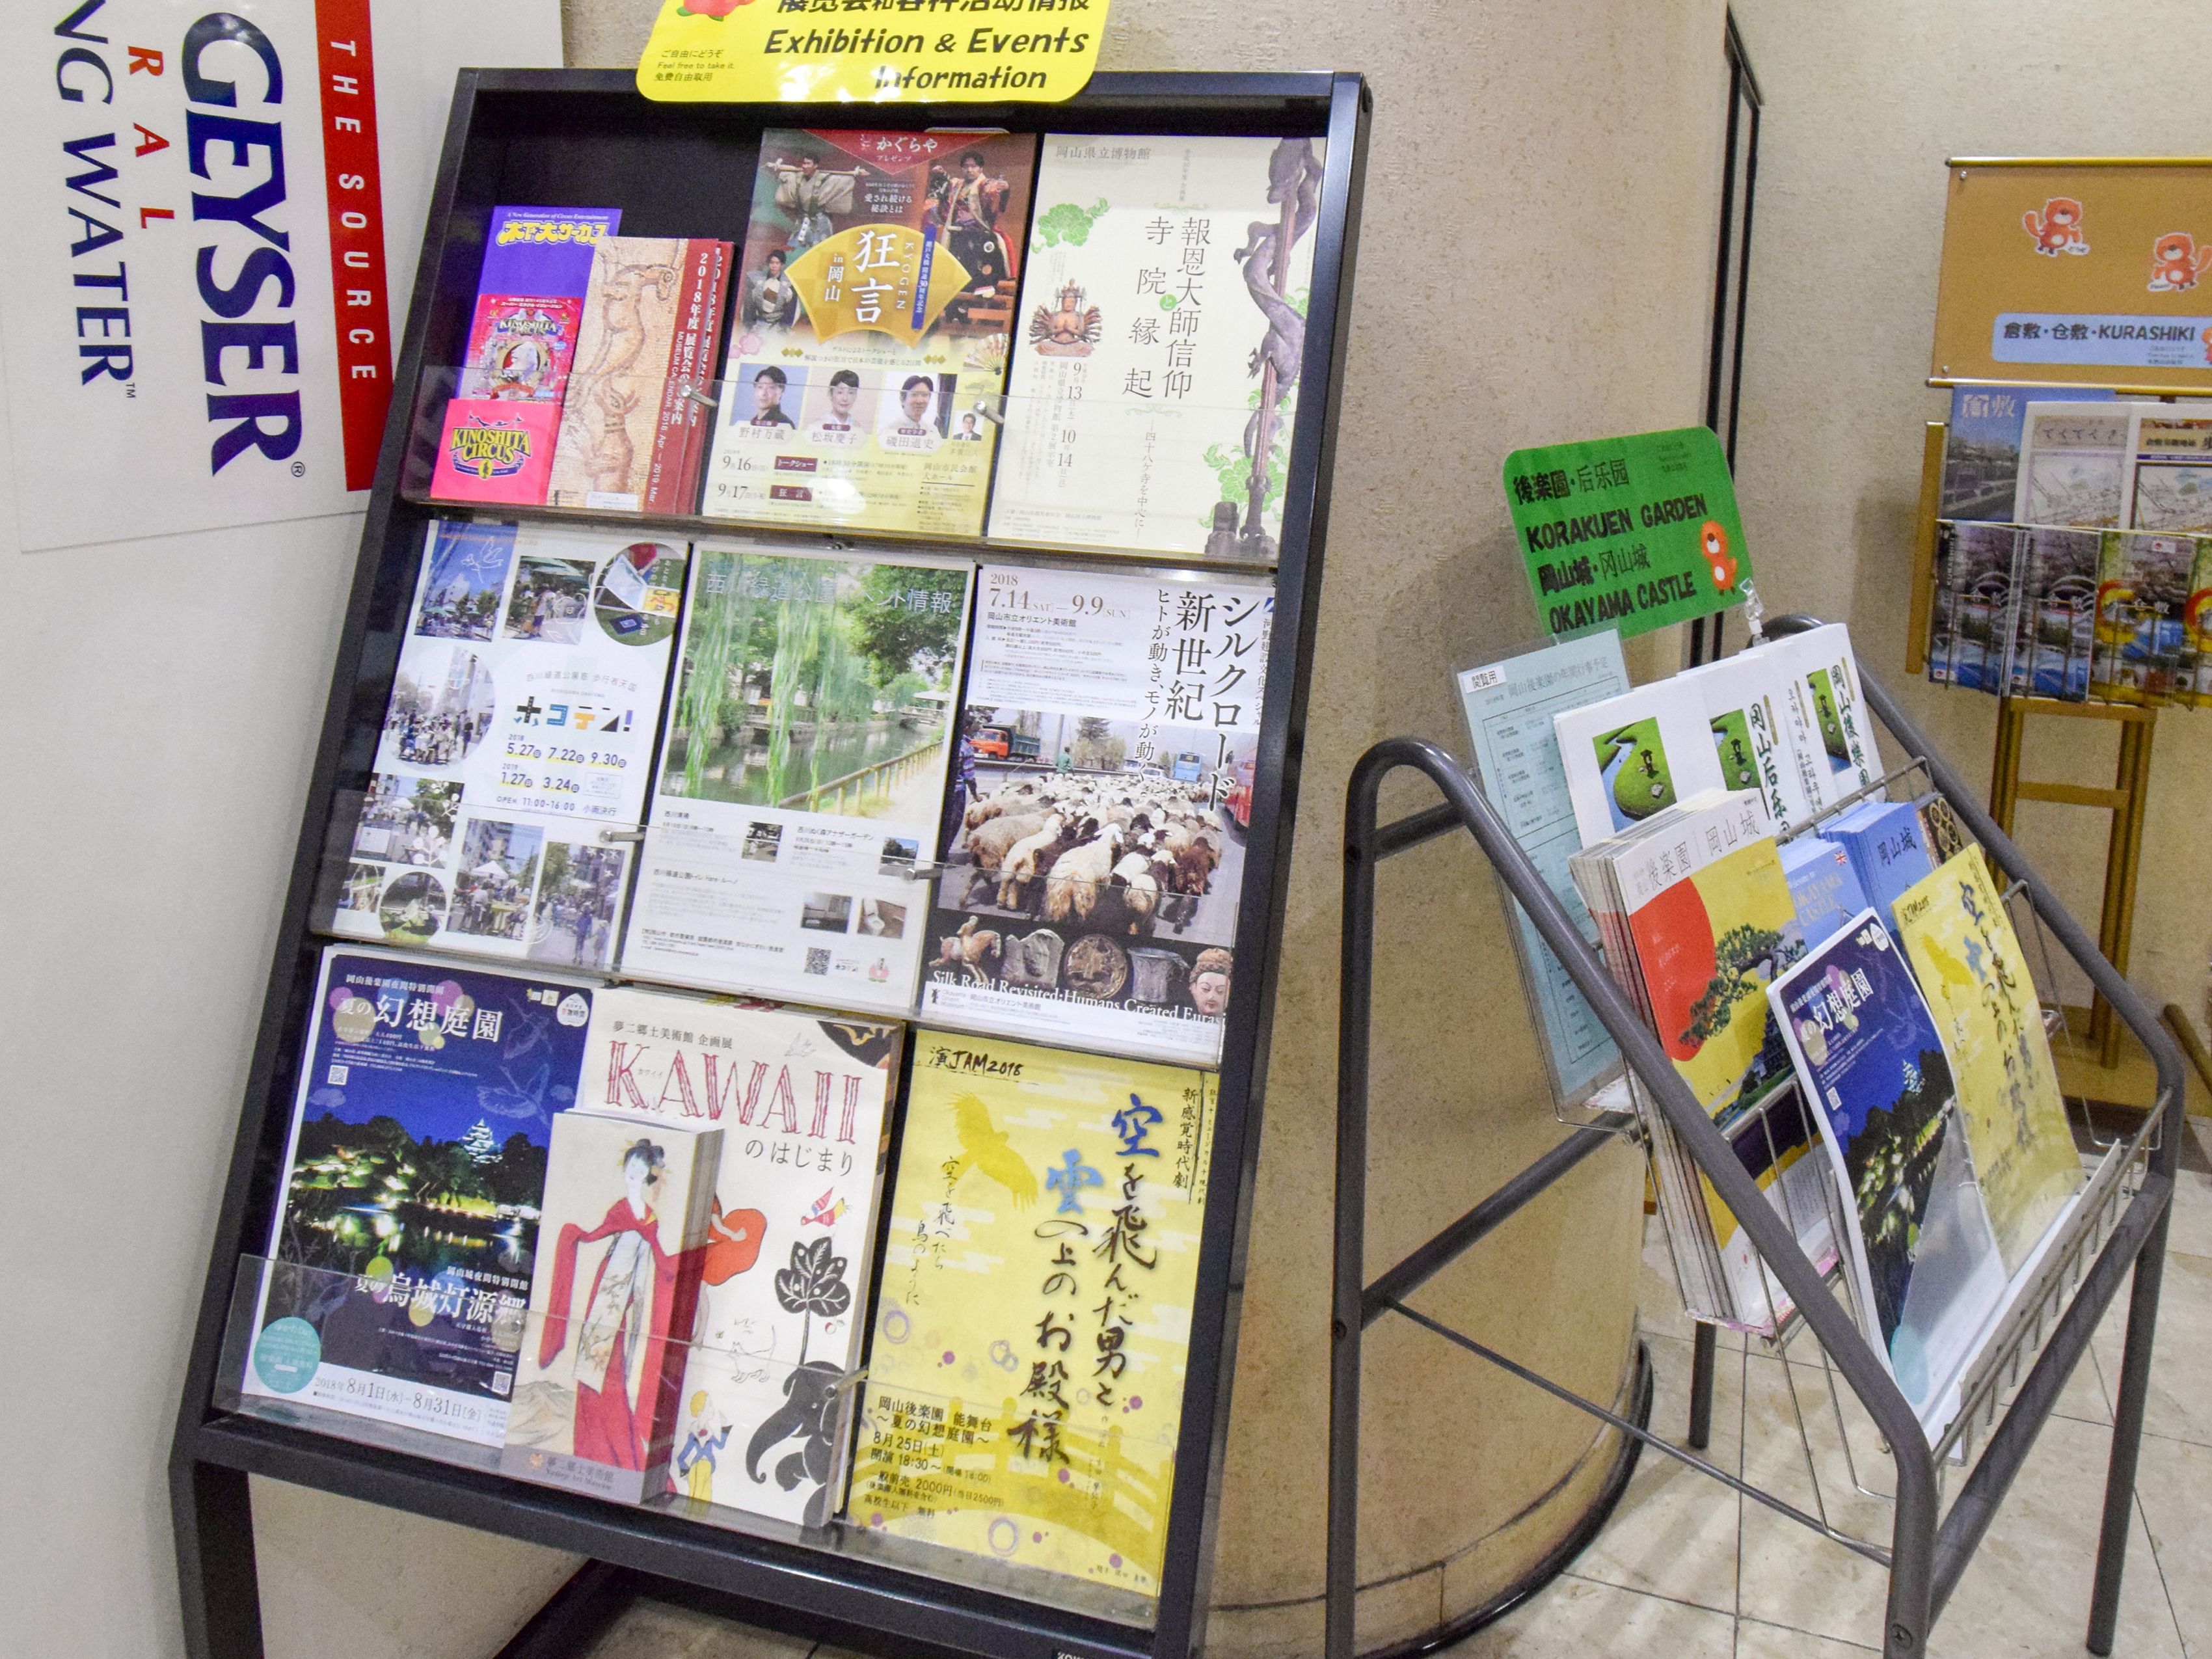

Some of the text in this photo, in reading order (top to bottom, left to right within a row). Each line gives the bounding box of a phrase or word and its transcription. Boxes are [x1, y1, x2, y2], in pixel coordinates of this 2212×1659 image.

[661, 49, 723, 59] ご自由にどうぞ
[764, 27, 1089, 54] Exhibition & Events
[875, 66, 1047, 89] Information
[876, 136, 937, 154] かぐらや
[1055, 145, 1152, 161] 岡山県立博物館
[330, 40, 376, 379] THE SOURCE
[62, 132, 135, 386] WATER
[182, 12, 303, 478] GEYSER
[687, 253, 708, 330] 2018年度
[824, 266, 844, 303] 岡山
[851, 230, 900, 323] 狂言
[897, 242, 915, 309] KYOGEN
[1122, 216, 1174, 398] 寺院縁起
[1163, 217, 1211, 400] 報恩大師信仰
[673, 331, 684, 364] MUSEUM
[450, 427, 531, 457] KINOSHITA
[462, 442, 515, 465] CIRCUS
[1526, 492, 1708, 553] KORAKUEN GARDEN
[990, 573, 1018, 586] 2018
[1548, 571, 1697, 635] OKAYAMA CASTLE
[987, 612, 1077, 628] 岡山市立オリエント美術館
[1163, 590, 1217, 722] 新世紀
[1471, 669, 1498, 690] 閲覧用
[1209, 596, 1261, 813] シルクロード
[1705, 810, 1760, 857] 岡山城
[1877, 826, 1918, 866] 岡山城
[933, 970, 957, 986] Silk
[961, 974, 995, 992] Road
[1124, 999, 1178, 1020] Created
[613, 1020, 733, 1049] 夢二郷土美術館 企画展
[604, 1040, 863, 1145] KAWAII
[746, 1139, 854, 1178] のはじまり
[1173, 1087, 1198, 1189] 新感覚時代劇
[933, 1155, 960, 1271] 空を飛べたら
[1092, 1092, 1164, 1407] 空を飛んだ男と
[1006, 1148, 1105, 1465] 雲の上のお殿様
[878, 1396, 992, 1432] 岡山後楽園 能舞台
[870, 1448, 894, 1463] 開演
